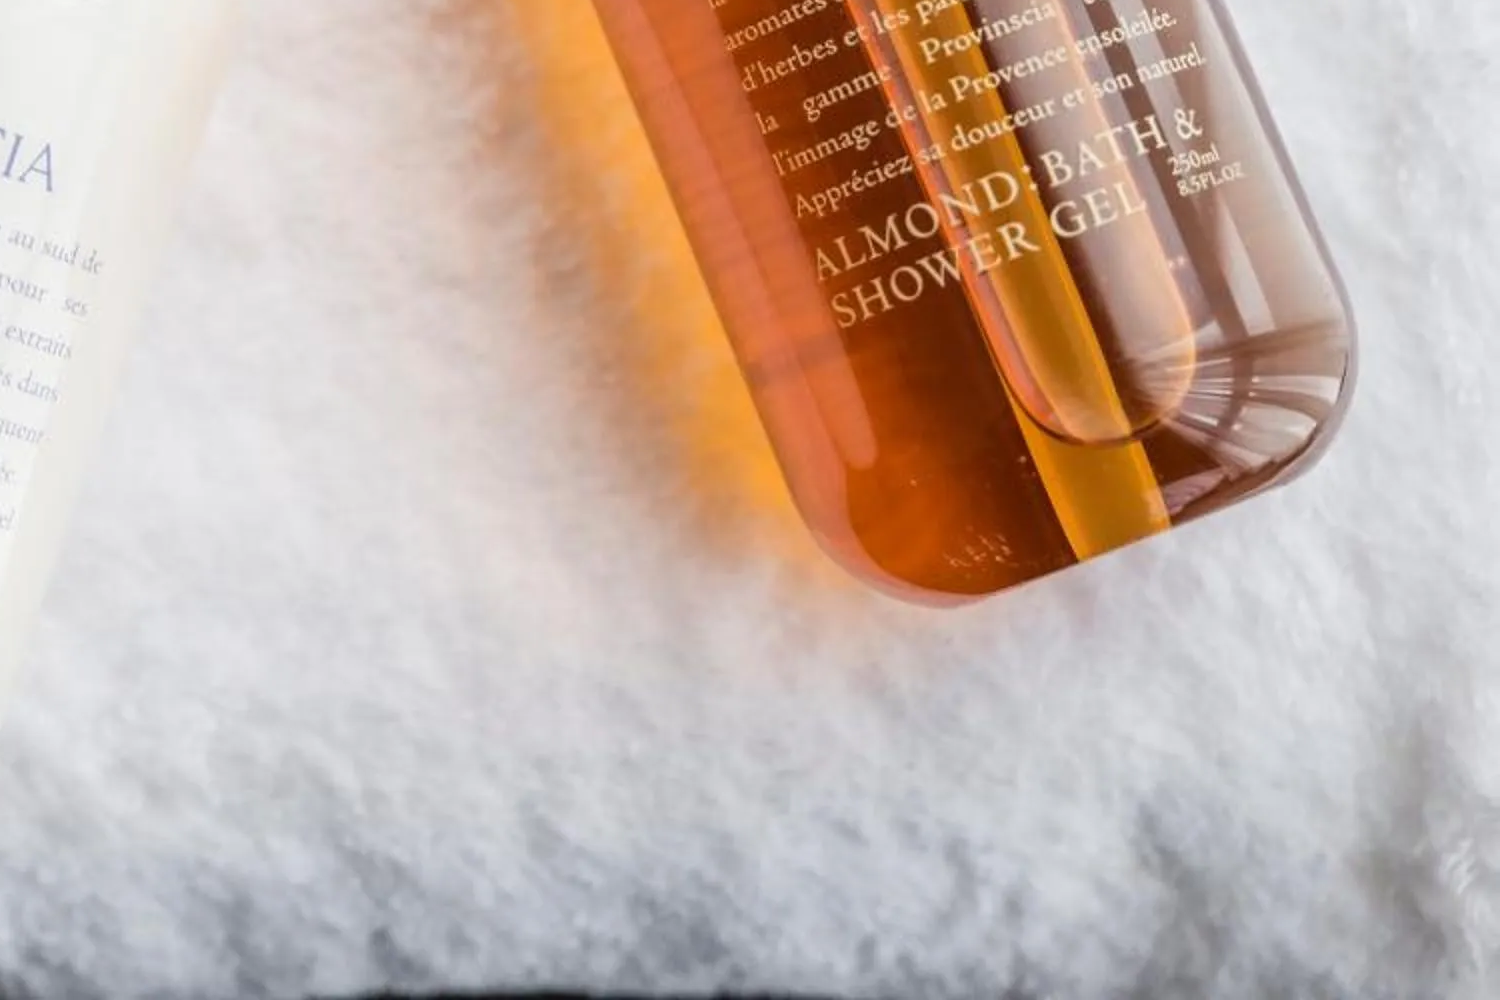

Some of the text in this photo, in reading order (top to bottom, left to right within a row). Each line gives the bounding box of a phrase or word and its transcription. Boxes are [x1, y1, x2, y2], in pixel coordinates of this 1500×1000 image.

[842, 22, 869, 46] et
[868, 9, 911, 35] les
[753, 110, 779, 135] la
[803, 65, 892, 122] gamme
[917, 0, 1056, 65] Provinscia
[884, 102, 918, 129] de
[916, 89, 947, 114] la
[947, 47, 1069, 102] Provence
[794, 154, 914, 220] Appréciez
[915, 142, 945, 165] sa
[949, 98, 1054, 150] douceur
[1061, 85, 1088, 109] et
[1091, 71, 1135, 98] son
[1168, 141, 1221, 176] 250ml
[818, 103, 1203, 282] ALMOND: BATH &
[7, 228, 36, 251] au
[41, 240, 81, 266] sud
[81, 247, 103, 274] de
[831, 181, 1148, 327] SHOWER GEL
[62, 295, 89, 317] ses
[4, 324, 73, 360] extraits
[17, 368, 60, 401] dans
